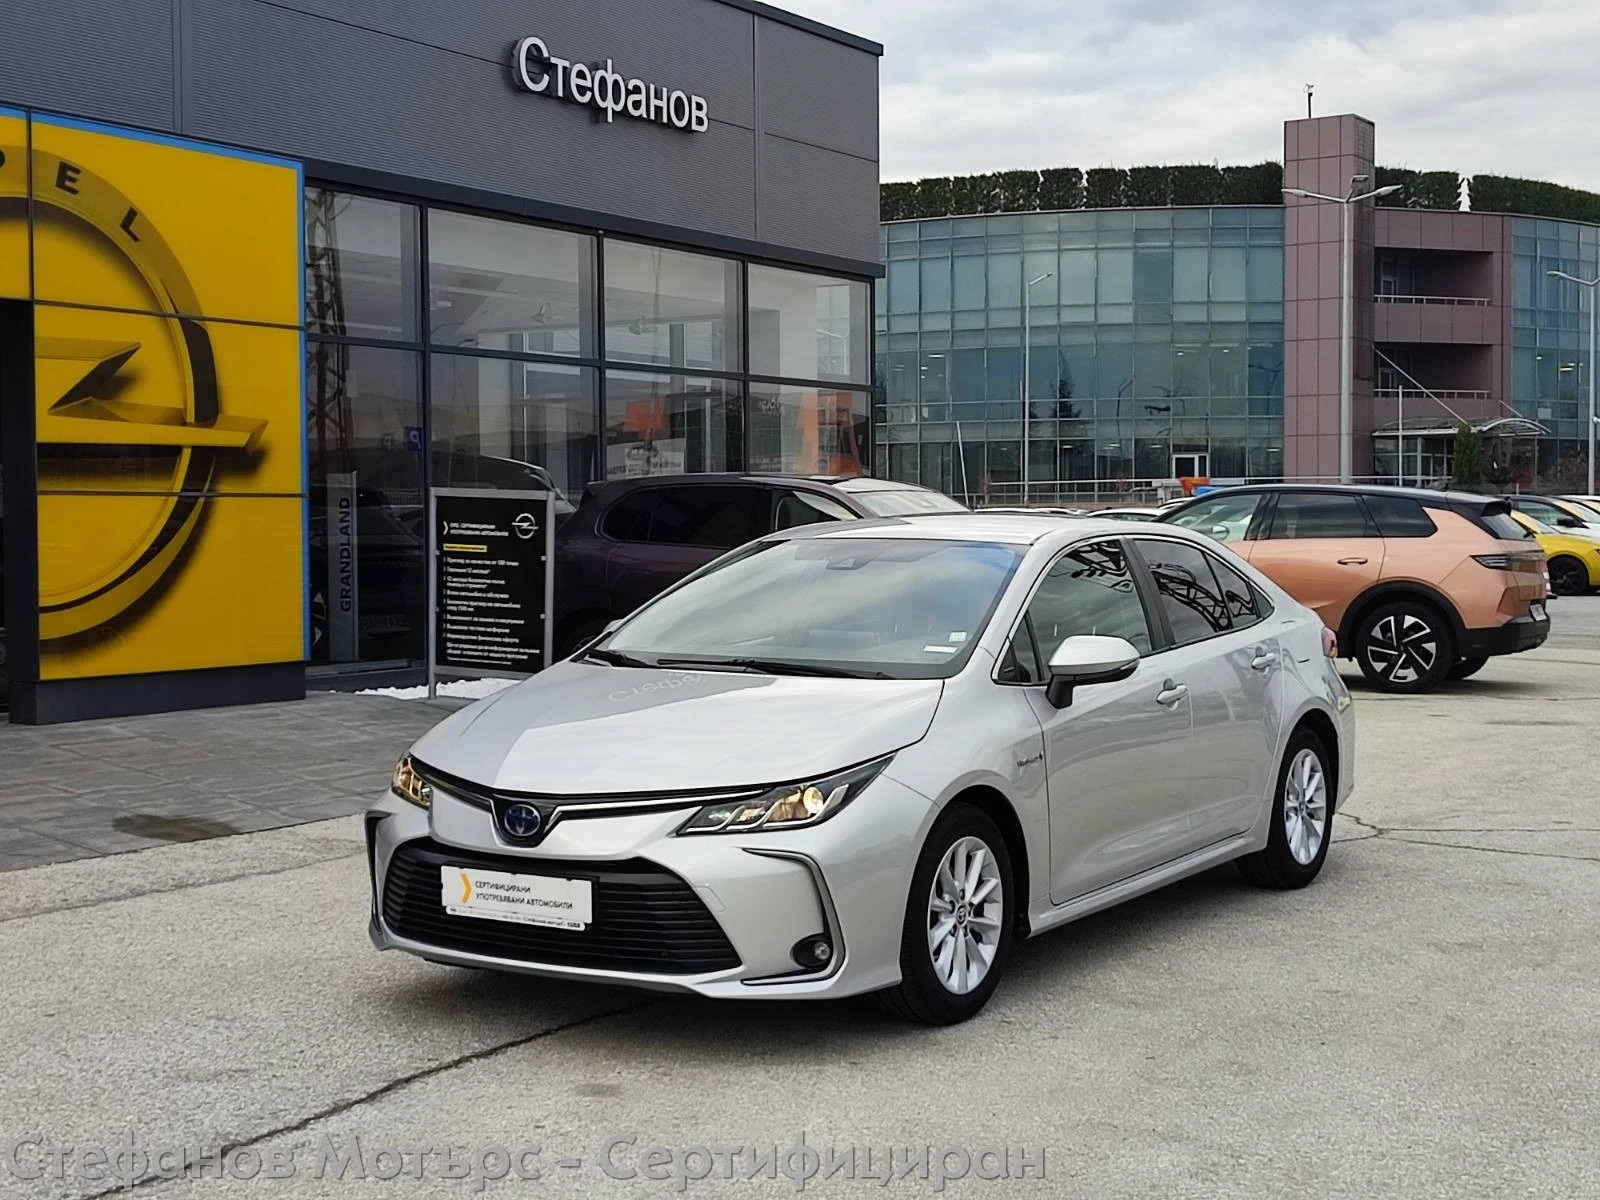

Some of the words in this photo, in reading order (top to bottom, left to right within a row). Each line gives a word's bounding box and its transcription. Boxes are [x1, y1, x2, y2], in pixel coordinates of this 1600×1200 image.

[517, 36, 709, 133] Стефанов
[339, 497, 351, 612] GRANDLAND
[474, 880, 532, 893] СЕРТИФИЦИРАНИ
[475, 893, 525, 904] УПОТРЕБЯВАНИ
[526, 898, 574, 910] АВТОМОБИЛИ
